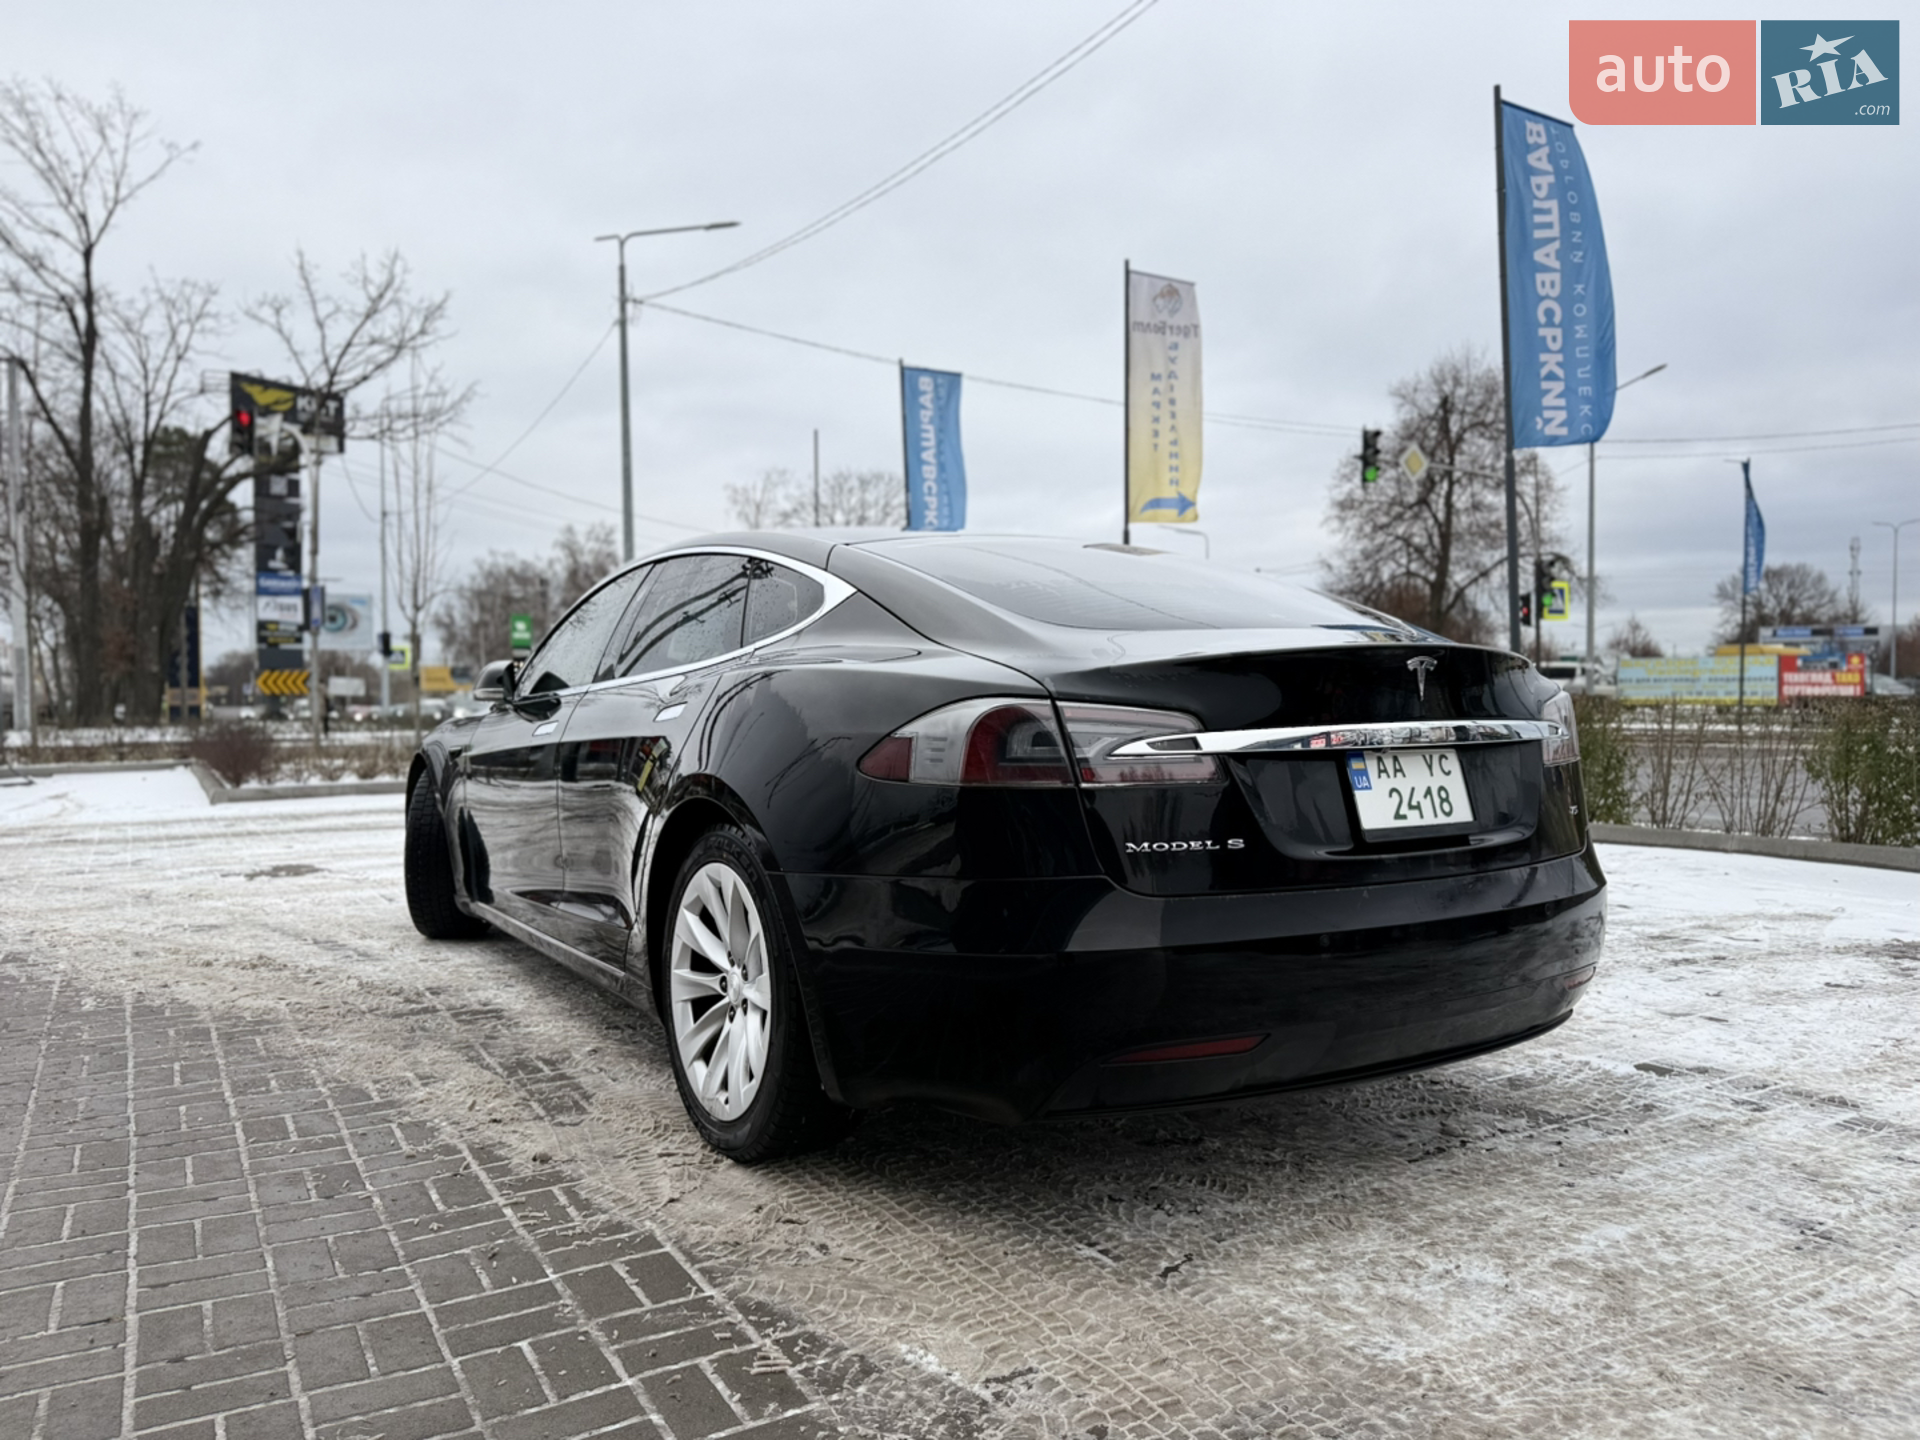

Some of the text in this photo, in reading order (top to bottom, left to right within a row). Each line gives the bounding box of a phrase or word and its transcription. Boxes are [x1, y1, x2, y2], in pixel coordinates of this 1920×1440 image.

[1376, 753, 1452, 779] AA YC
[1354, 775, 1370, 789] UA
[1388, 785, 1453, 821] 2418
[1125, 838, 1245, 853] MODEL S
